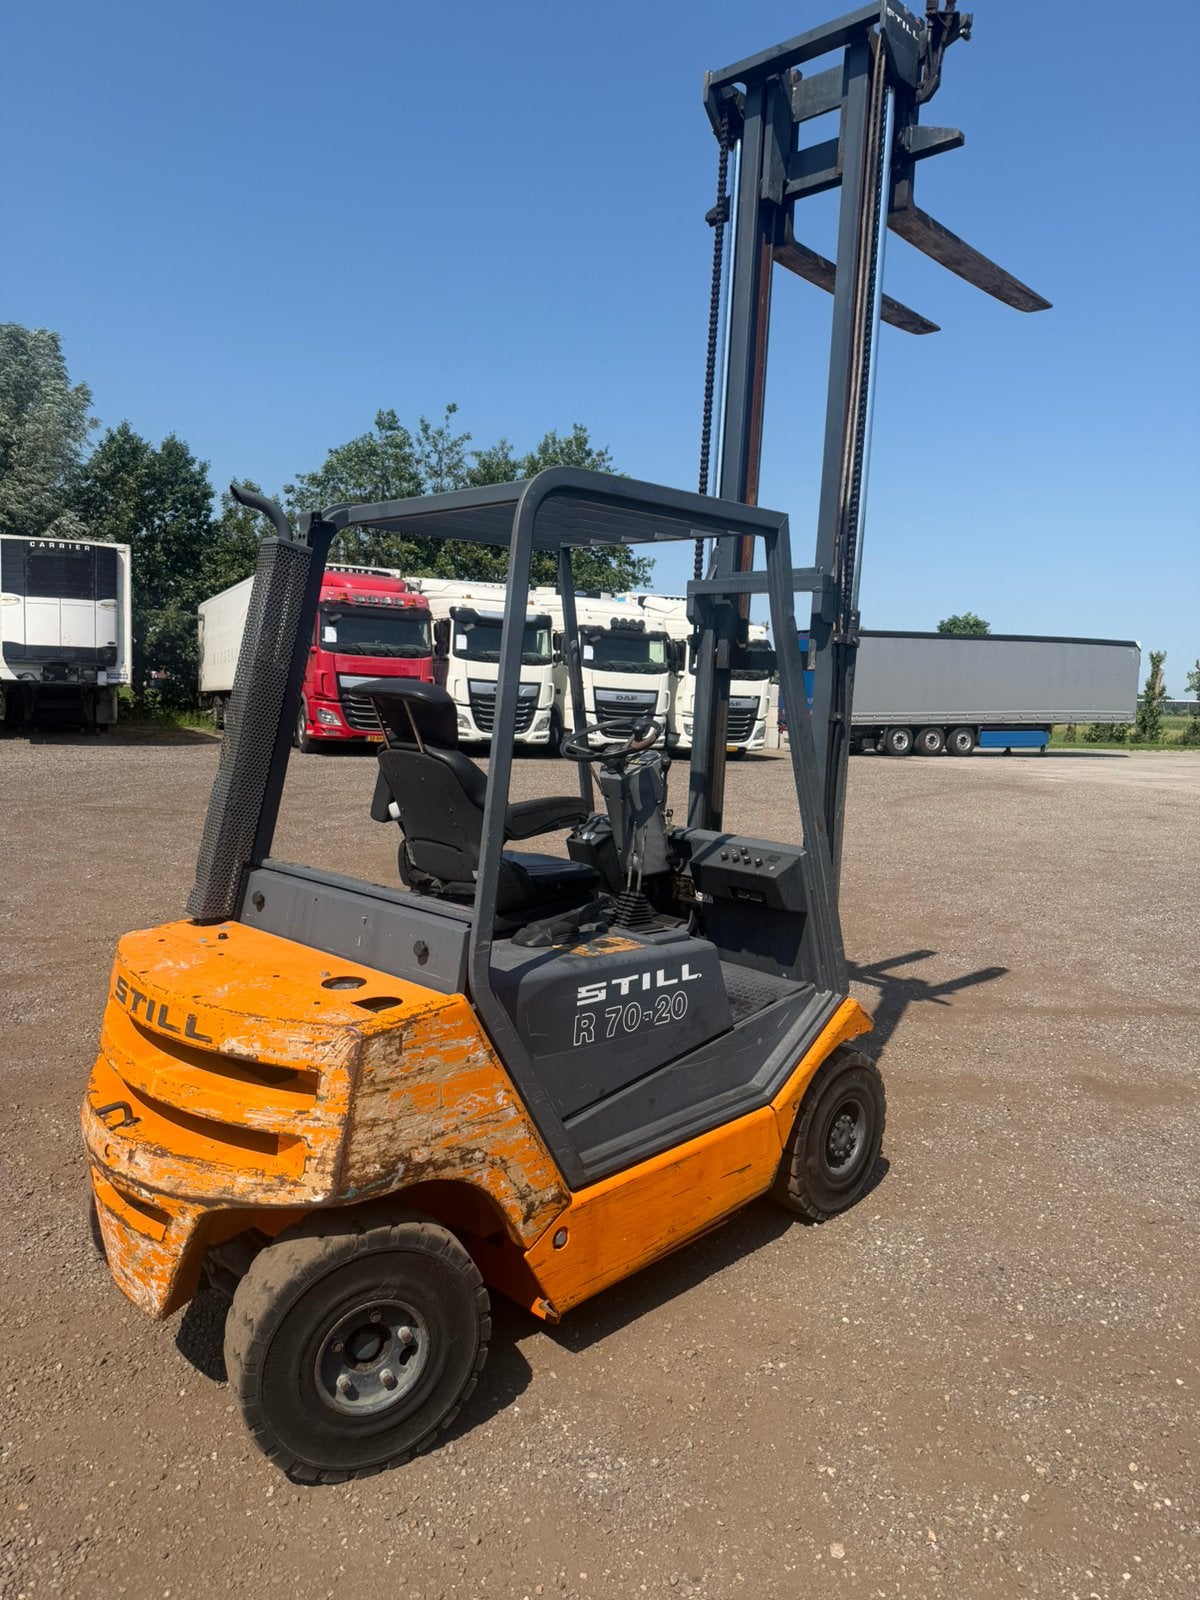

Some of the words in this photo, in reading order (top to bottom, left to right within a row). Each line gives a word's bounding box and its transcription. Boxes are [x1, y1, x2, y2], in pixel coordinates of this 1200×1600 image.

[886, 7, 919, 41] STILL
[29, 541, 91, 551] CARRIER
[576, 963, 702, 1006] STILL
[114, 974, 213, 1044] STILL
[573, 1012, 596, 1047] R
[605, 990, 689, 1038] 70-20
